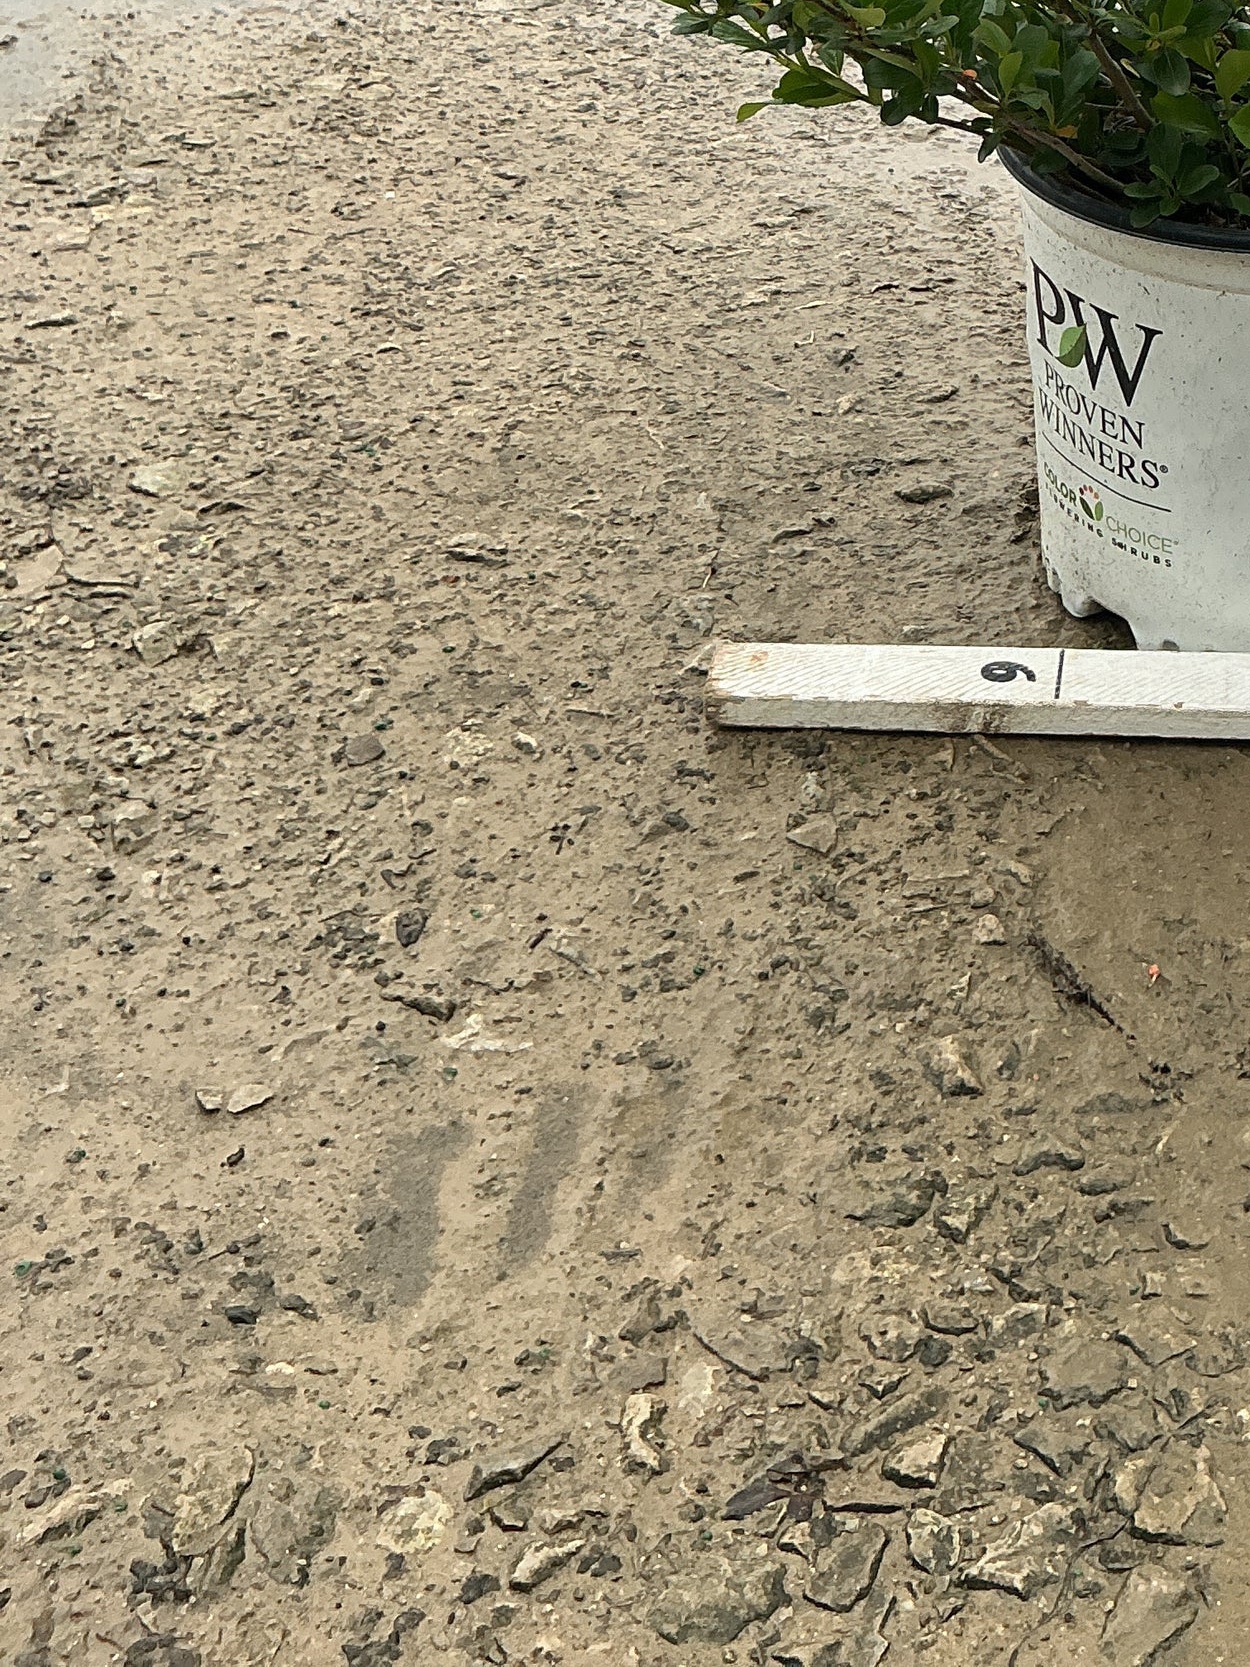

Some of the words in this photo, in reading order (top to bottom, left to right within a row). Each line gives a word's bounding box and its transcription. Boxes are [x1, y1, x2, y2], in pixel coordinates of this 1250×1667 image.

[1030, 256, 1164, 408] PW
[1044, 358, 1146, 450] PROVEN
[1043, 461, 1078, 508] COLOR
